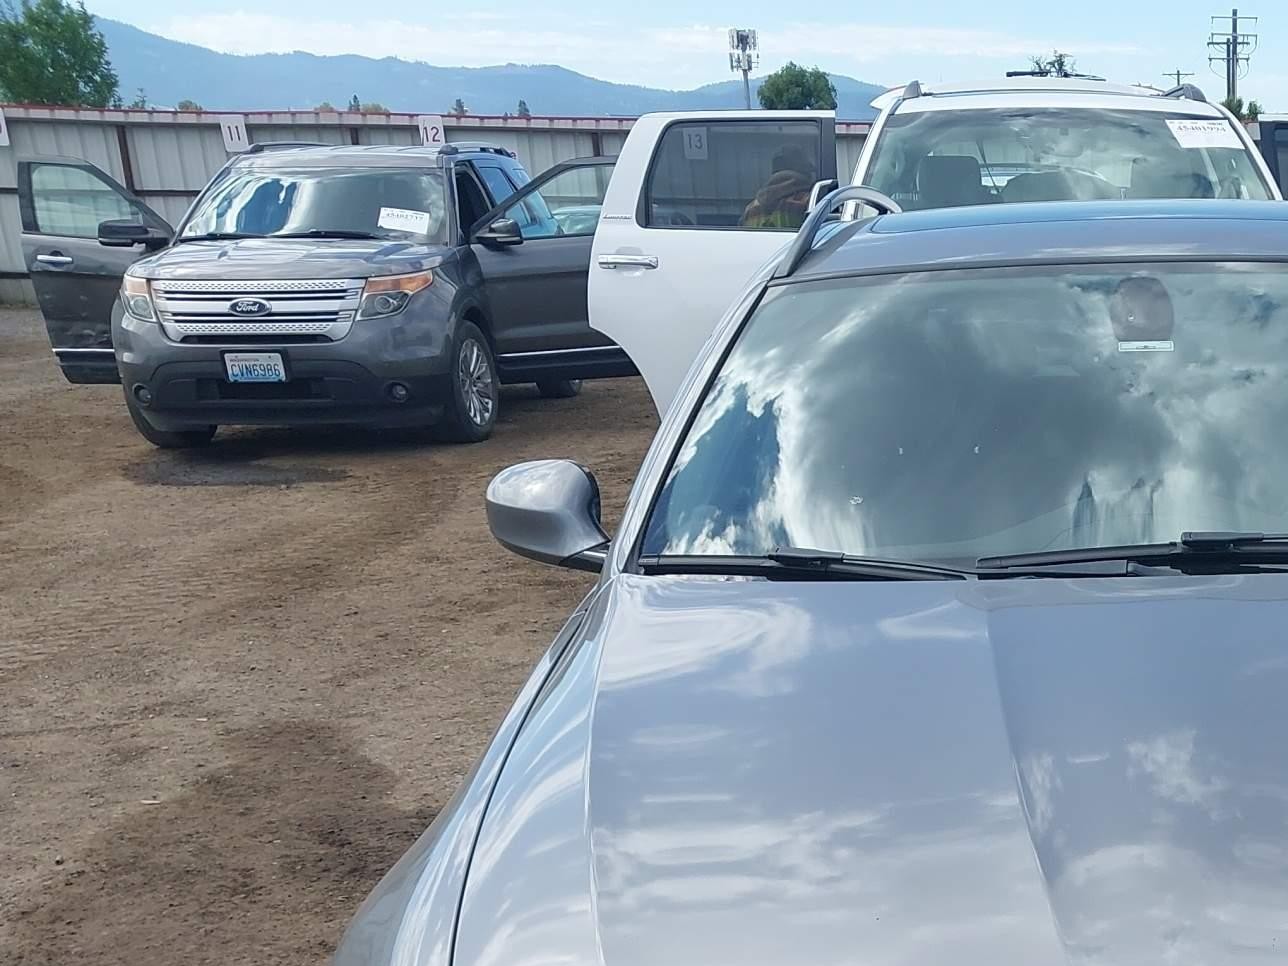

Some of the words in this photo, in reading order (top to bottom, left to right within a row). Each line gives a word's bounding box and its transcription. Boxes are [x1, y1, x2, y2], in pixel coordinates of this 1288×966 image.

[227, 125, 241, 142] 11
[423, 126, 441, 143] 12
[687, 134, 703, 149] 13
[236, 301, 260, 312] Ford
[230, 363, 281, 377] CVN6986
